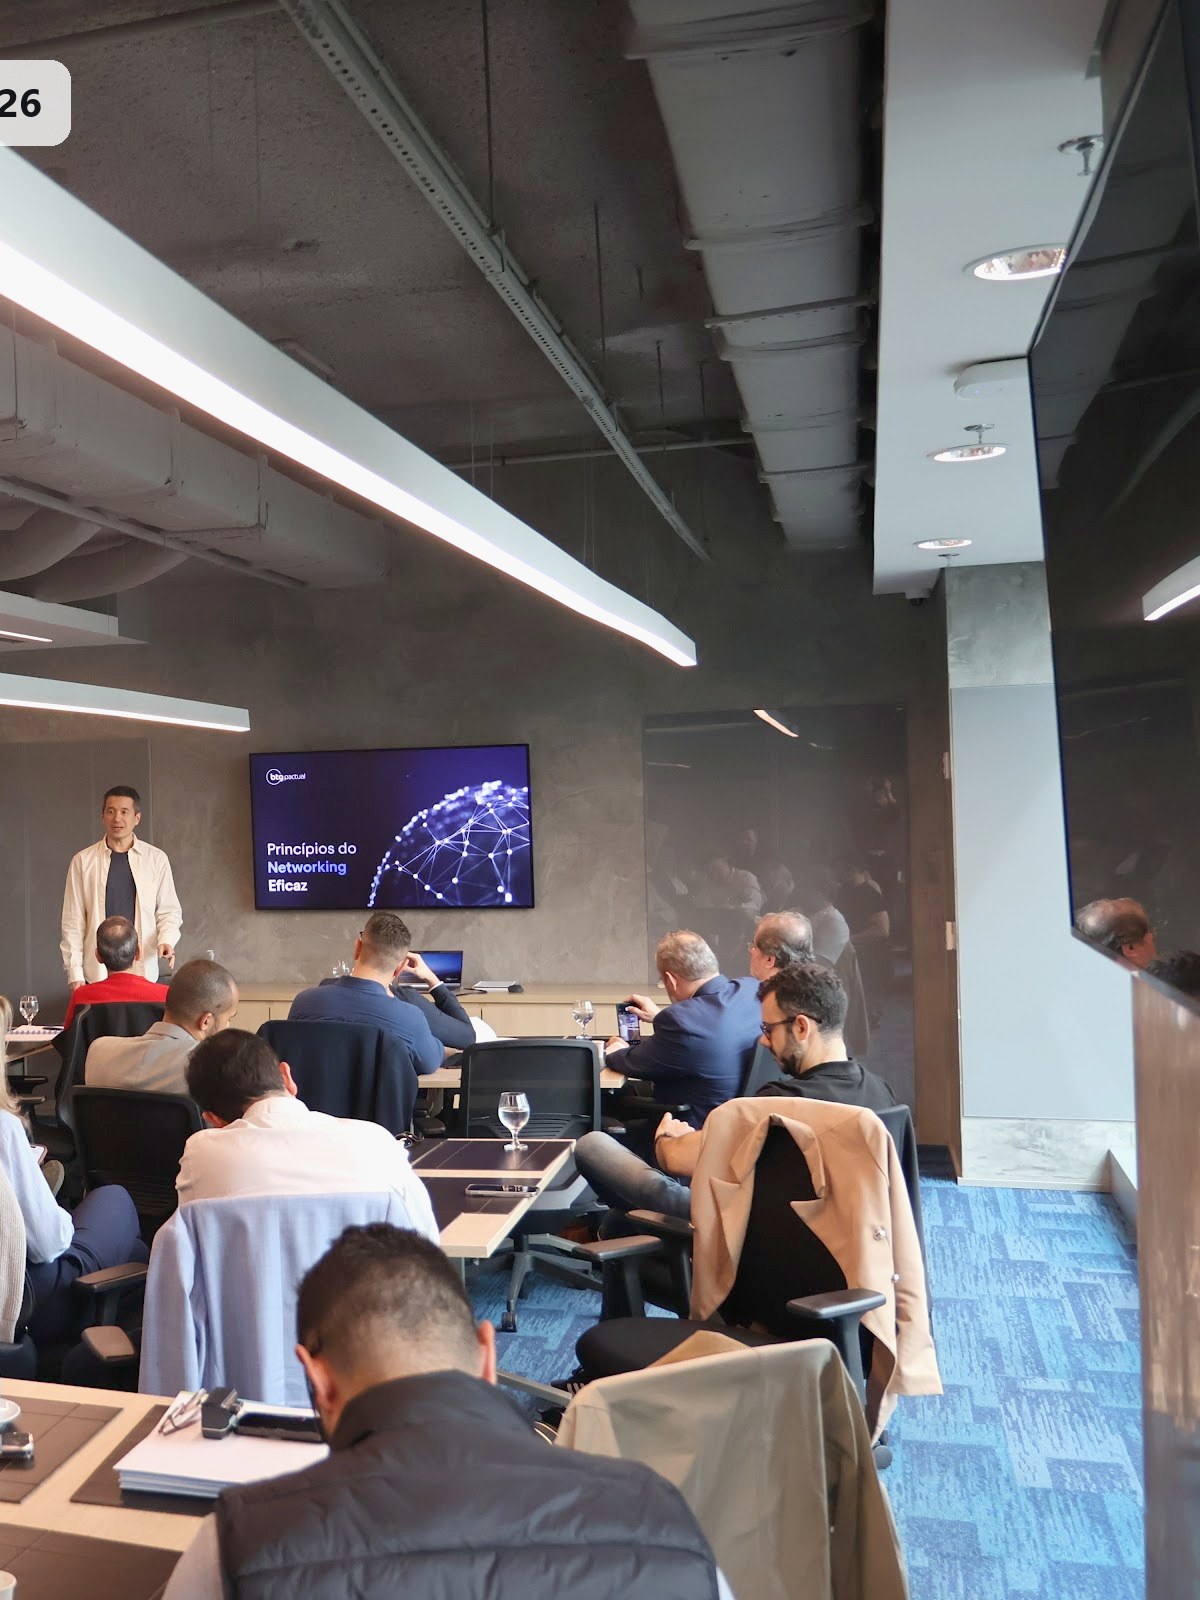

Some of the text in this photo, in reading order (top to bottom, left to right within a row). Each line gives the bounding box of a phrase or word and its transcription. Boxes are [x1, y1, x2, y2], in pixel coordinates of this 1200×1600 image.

[267, 842, 357, 858] Princípios do
[267, 861, 347, 876] Networking
[268, 879, 308, 892] Eficaz
